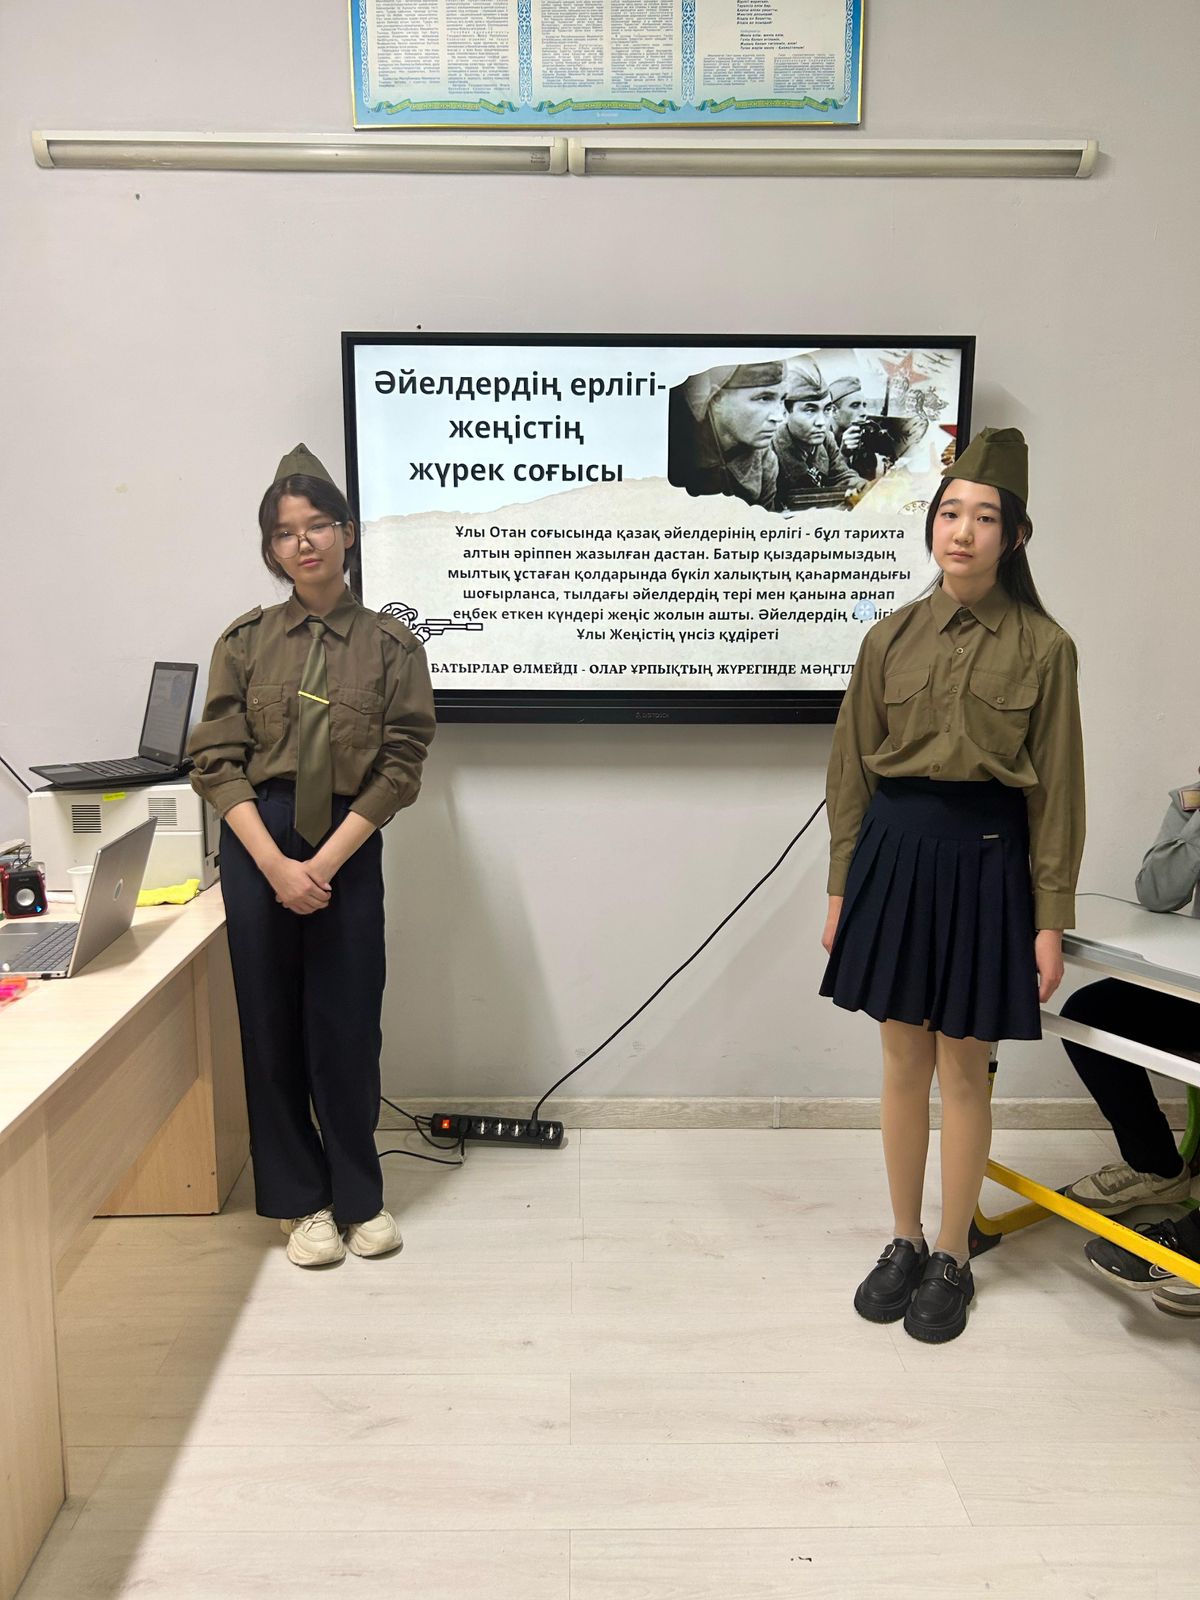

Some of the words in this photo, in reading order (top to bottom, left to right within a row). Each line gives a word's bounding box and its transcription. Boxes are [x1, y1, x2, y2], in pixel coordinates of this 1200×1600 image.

[374, 368, 562, 403] Әйелдердің
[570, 371, 667, 404] ерлігі-
[448, 414, 585, 446] жеңістің
[409, 462, 505, 488] жүрек
[513, 463, 623, 483] соғысы
[455, 525, 485, 538] Ұлы
[489, 526, 526, 539] Отан
[530, 528, 612, 542] соғысында
[616, 529, 661, 542] қазақ
[663, 526, 756, 543] әйелдерінің
[759, 526, 802, 543] ерлігі
[814, 526, 840, 543] бұл
[844, 529, 905, 543] тарихта
[463, 549, 510, 560] алтын
[514, 546, 572, 563] әріппен
[575, 549, 650, 561] жазылған
[653, 550, 709, 563] дастан.
[713, 547, 760, 564] Батыр
[763, 550, 897, 564] қыздарымыздың
[448, 569, 511, 582] мылтық
[513, 570, 570, 583] ұстаған
[574, 570, 667, 584] қолдарында
[671, 567, 710, 584] бүкіл
[713, 570, 792, 583] халықтың
[463, 589, 559, 603] шоғырланса,
[563, 590, 629, 603] тылдағы
[632, 587, 720, 604] әйелдердің
[722, 587, 752, 604] тері
[756, 590, 786, 601] мен
[789, 590, 847, 603] қанына
[850, 590, 896, 602] арнап
[452, 607, 498, 624] еңбек
[501, 610, 543, 621] еткен
[547, 607, 604, 624] күндері
[607, 607, 650, 623] жеңіс
[653, 611, 705, 622] жолын
[708, 611, 754, 623] ашты.
[758, 607, 848, 624] Әйелдердің
[576, 628, 606, 640] Ұлы
[609, 627, 676, 643] Жеңістің
[678, 627, 715, 644] үнсіз
[719, 627, 779, 644] құдіреті
[430, 662, 509, 675] БАТЫРЛАР
[512, 660, 578, 676] ӨЛМЕЙДІ
[589, 663, 628, 676] ОЛАР
[630, 663, 714, 677] ҰРПЫҚТЫҢ
[716, 663, 797, 677] ЖҮРЕГІНДЕ
